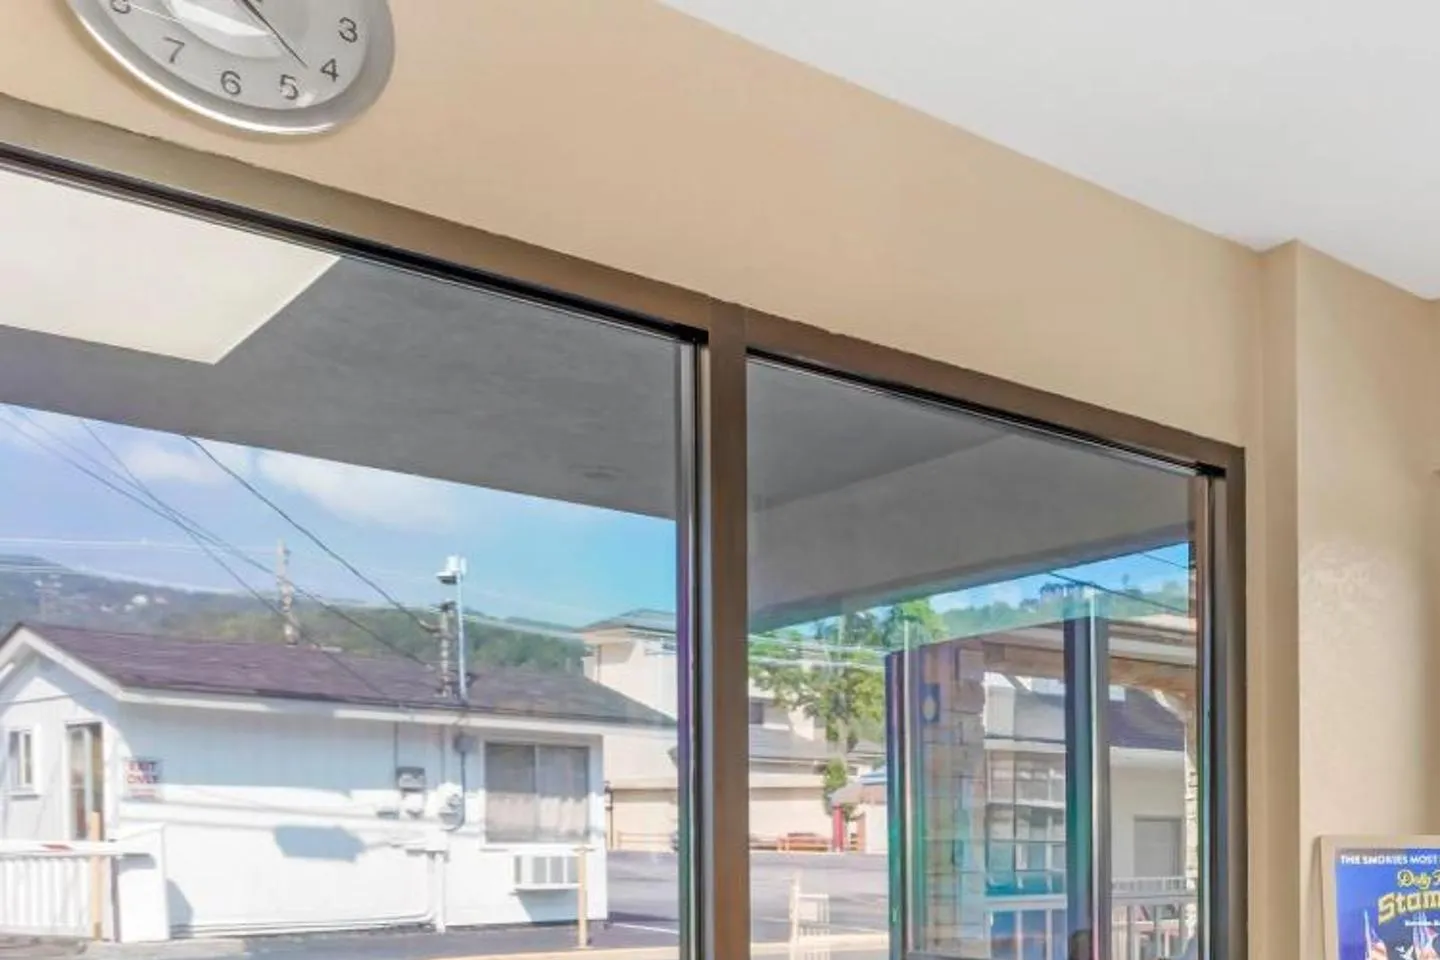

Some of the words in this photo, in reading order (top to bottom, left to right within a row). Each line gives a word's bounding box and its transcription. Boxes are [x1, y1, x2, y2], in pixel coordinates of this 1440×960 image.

[338, 16, 359, 43] 3
[163, 36, 185, 63] 7
[220, 70, 242, 96] 6
[319, 58, 340, 82] 4
[279, 73, 299, 100] 5
[1340, 855, 1360, 865] THE
[1363, 855, 1408, 865] SMOKIES
[1410, 855, 1437, 865] MOST
